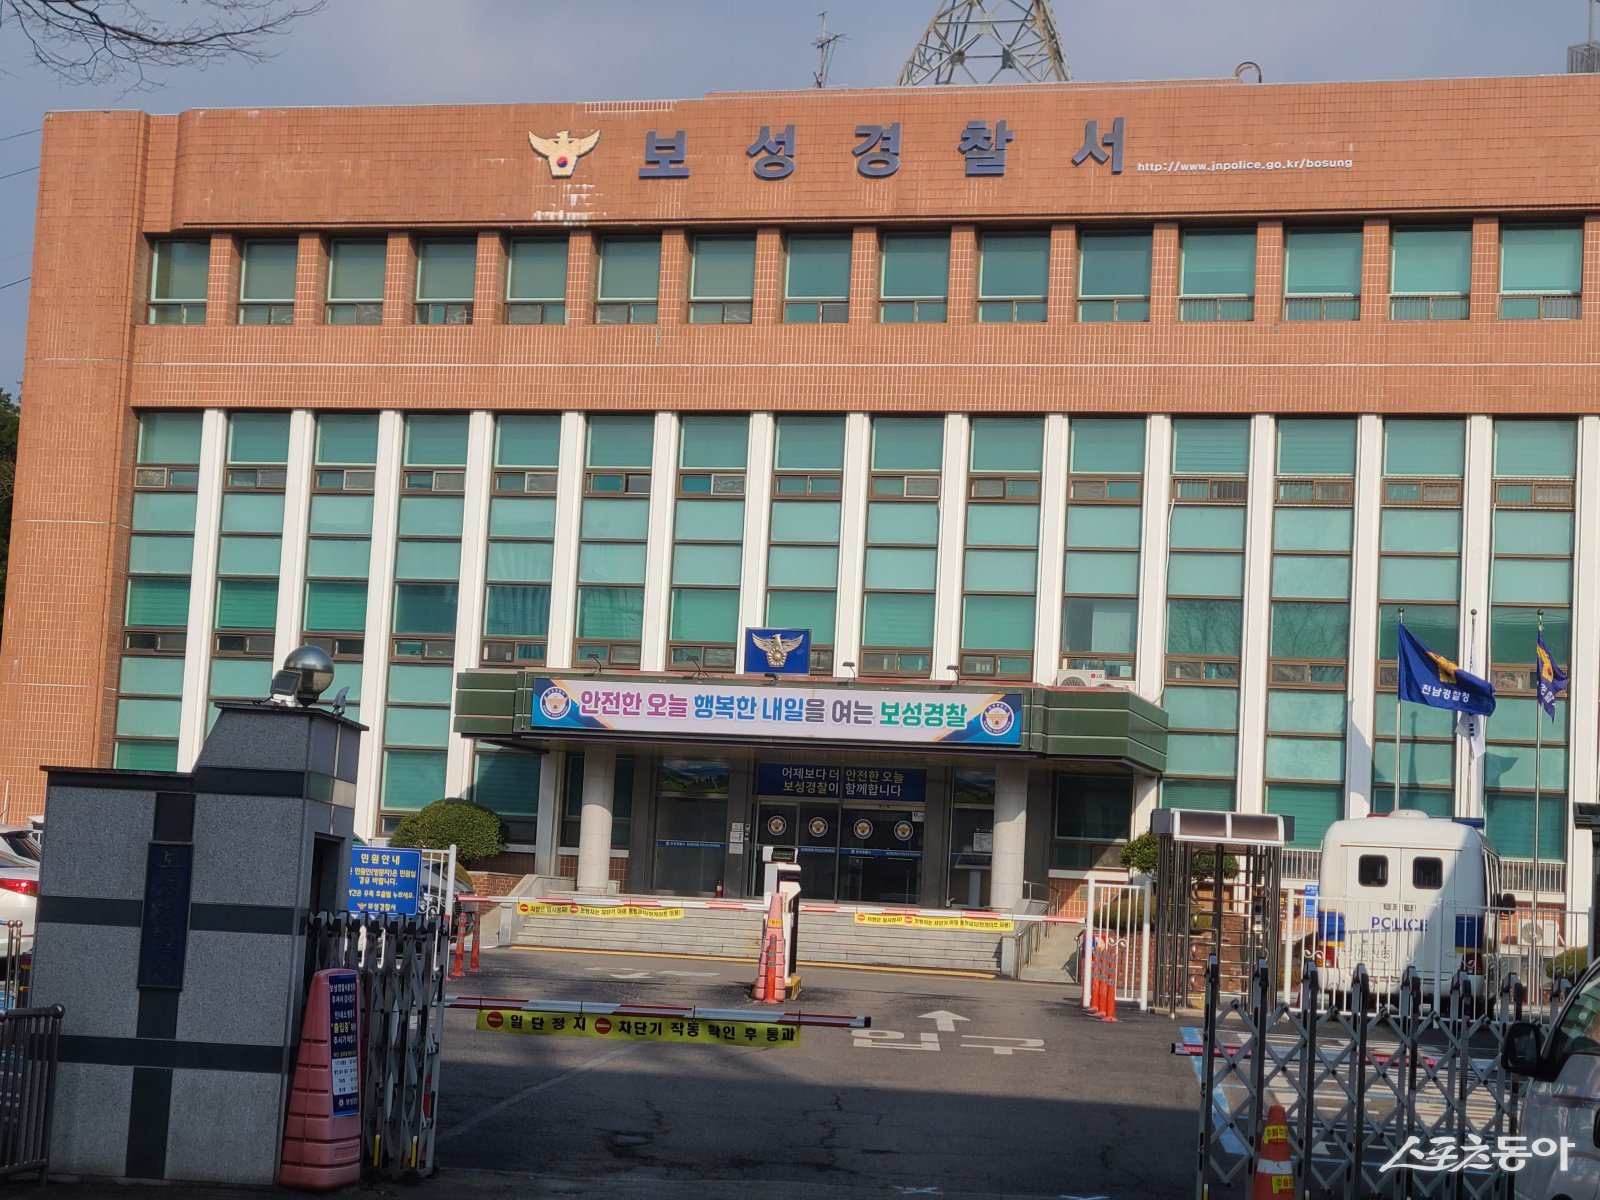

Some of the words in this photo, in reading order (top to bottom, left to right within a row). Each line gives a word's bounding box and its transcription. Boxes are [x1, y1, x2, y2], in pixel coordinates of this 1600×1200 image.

[1137, 158, 1353, 172] http://www.jnpolice.go.kr/bosung
[1421, 684, 1470, 703] 전남경찰청
[580, 690, 642, 716] 안전한
[646, 693, 688, 718] 오늘
[694, 694, 757, 721] 행복한
[762, 697, 825, 723] 내일을
[831, 699, 874, 725] 여는
[879, 701, 967, 729] 보성경찰
[782, 767, 826, 780] 어제보다
[829, 768, 840, 781] 더
[846, 769, 879, 783] 안전한
[881, 771, 904, 784] 오늘
[783, 781, 839, 794] 보성경찰이
[845, 783, 902, 797] 함께합니다
[361, 853, 400, 865] 민원안내
[1371, 916, 1428, 931] POLICE
[510, 1014, 586, 1031] 일단정지
[618, 1020, 662, 1036] 차단기
[670, 1021, 700, 1037] 작동
[708, 1023, 735, 1040] 확인
[744, 1027, 757, 1041] 후
[766, 1026, 795, 1041] 통과
